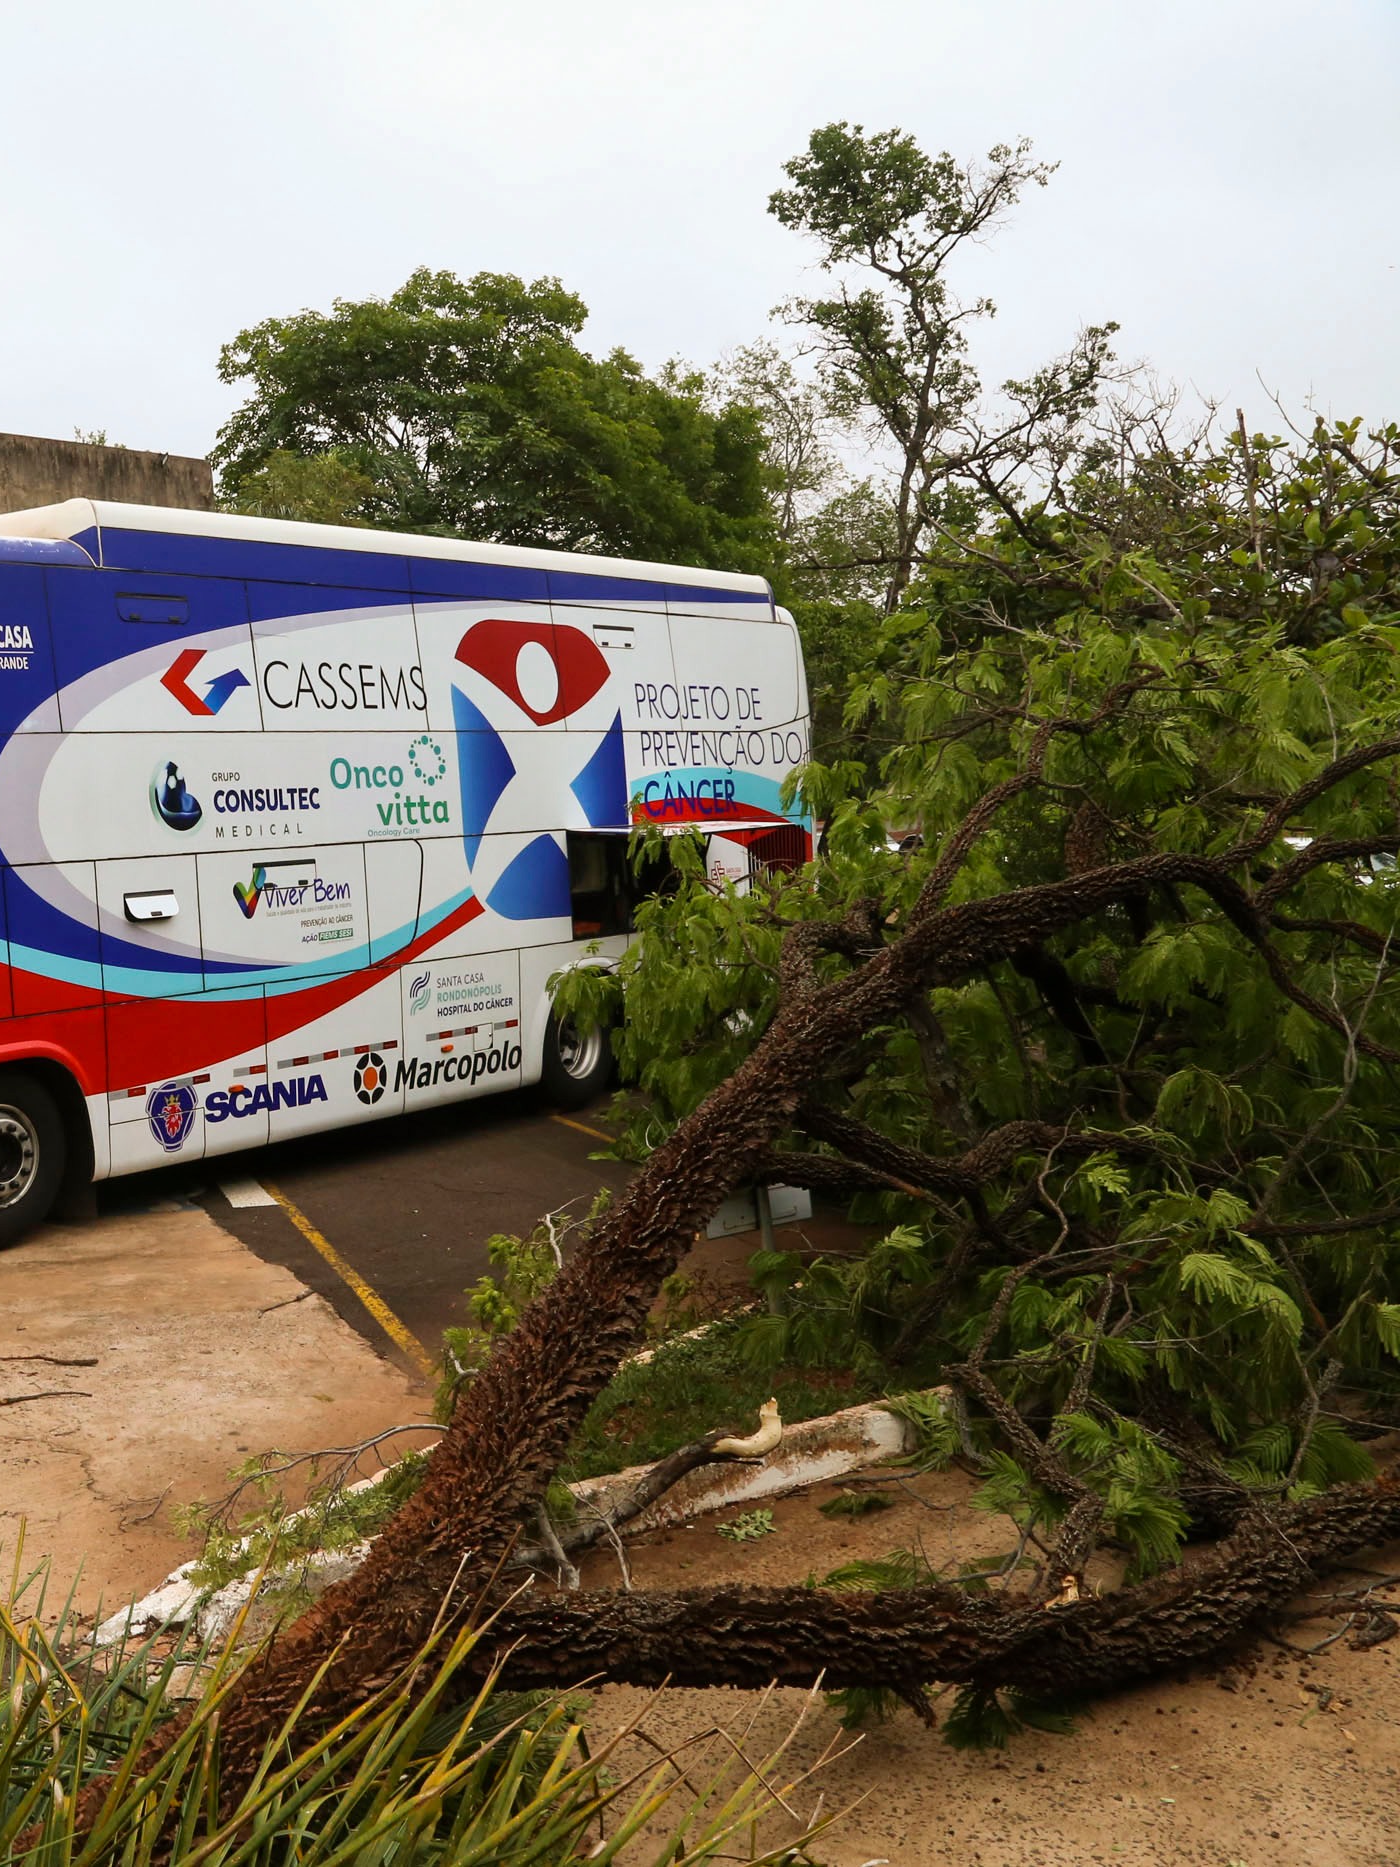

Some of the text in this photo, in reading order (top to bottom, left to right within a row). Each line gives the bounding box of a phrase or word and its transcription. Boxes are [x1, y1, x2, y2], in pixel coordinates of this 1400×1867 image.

[263, 660, 428, 711] CASSEMS
[634, 683, 763, 721] PROJETO DE
[640, 725, 803, 775] PREVENÇÃO DO
[211, 772, 241, 783] GRUPO
[329, 757, 404, 790] Onco
[213, 787, 321, 814] CONSULTEC
[376, 792, 450, 826] vitta
[644, 771, 738, 818] CÂNCER
[215, 823, 303, 839] MEDICAL
[367, 827, 421, 838] Oncology Care
[263, 878, 351, 909] Viver Bem
[300, 916, 328, 929] PREVENÇÃO
[336, 914, 354, 924] CÂNCER
[301, 934, 318, 944] AÇÃO
[436, 972, 485, 989] SANTA CASA
[436, 984, 503, 1003] RONDONÓPOLIS
[437, 996, 514, 1017] HOSPITAL DO CÂNCER
[394, 1040, 523, 1093] Marcopolo
[204, 1074, 329, 1124] SCANIA
